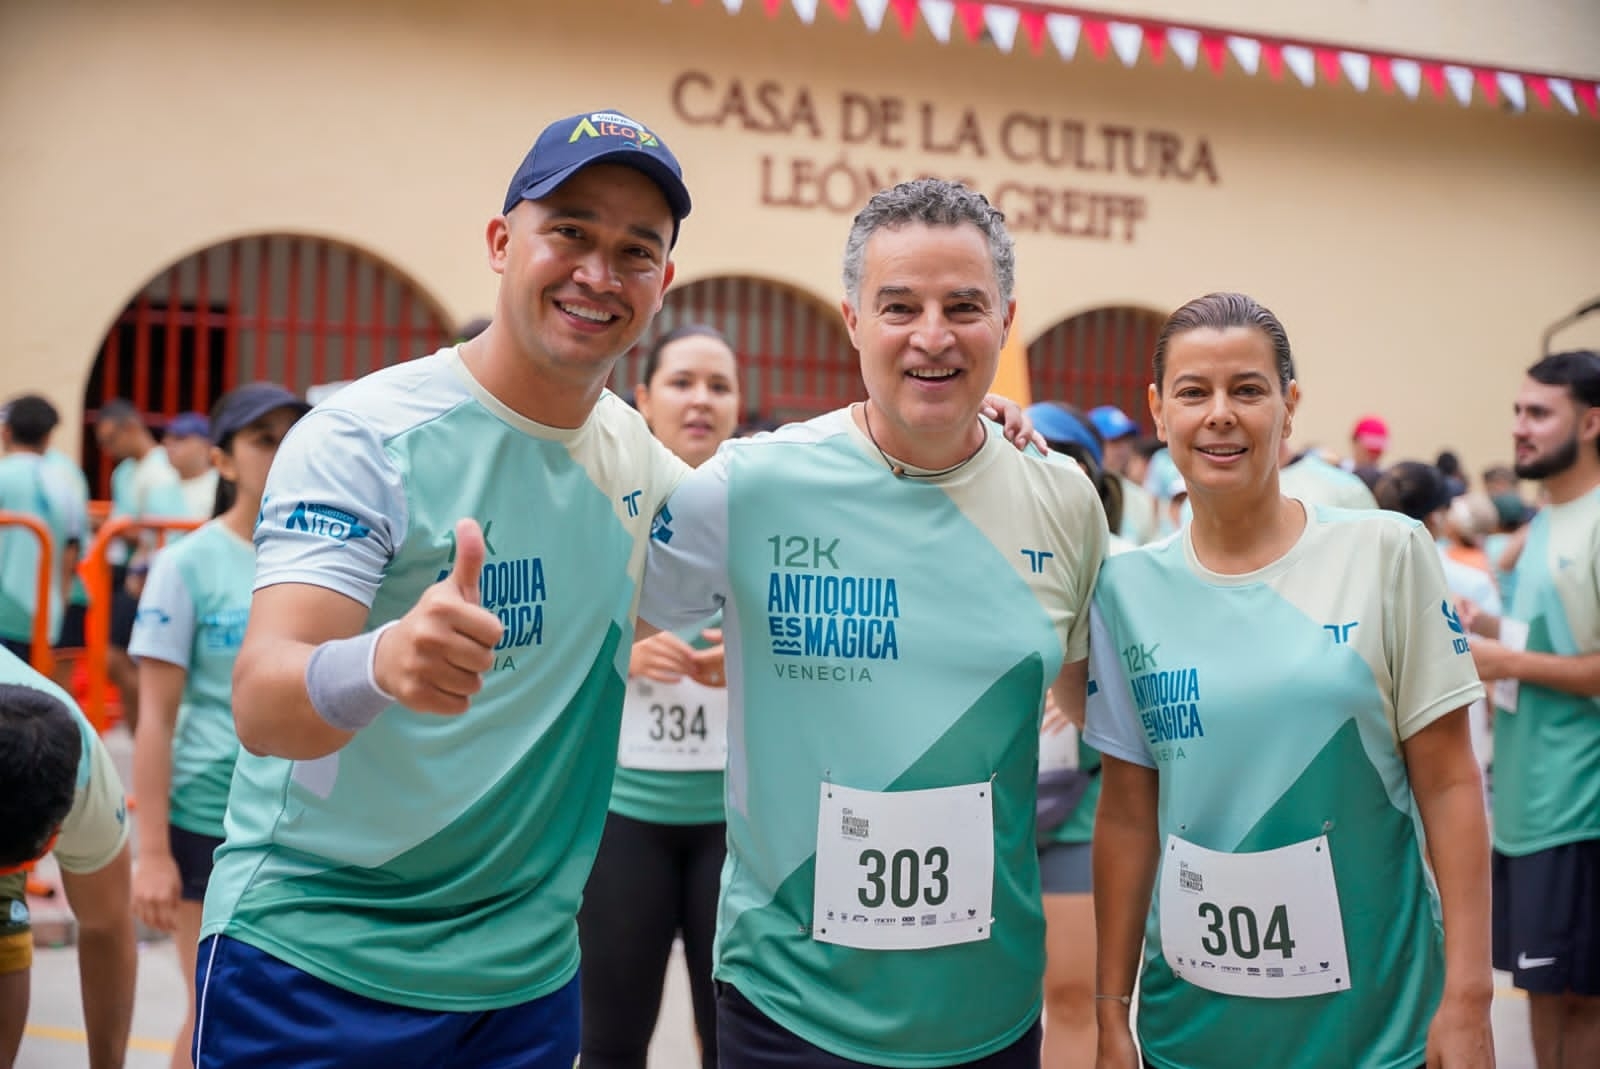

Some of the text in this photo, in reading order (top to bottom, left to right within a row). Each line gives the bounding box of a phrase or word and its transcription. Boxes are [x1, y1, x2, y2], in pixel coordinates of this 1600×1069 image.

[671, 70, 1219, 184] CASA DE LA CULTURA
[993, 181, 1147, 241] GREIFF
[767, 534, 841, 569] 12K
[768, 572, 899, 618] ANTIOQUIA
[769, 608, 899, 660] ES MÁGICA
[1122, 643, 1160, 673] 12K
[774, 663, 873, 683] VENECIA
[649, 703, 708, 742] 334
[858, 846, 949, 908] 303
[1198, 902, 1296, 960] 304
